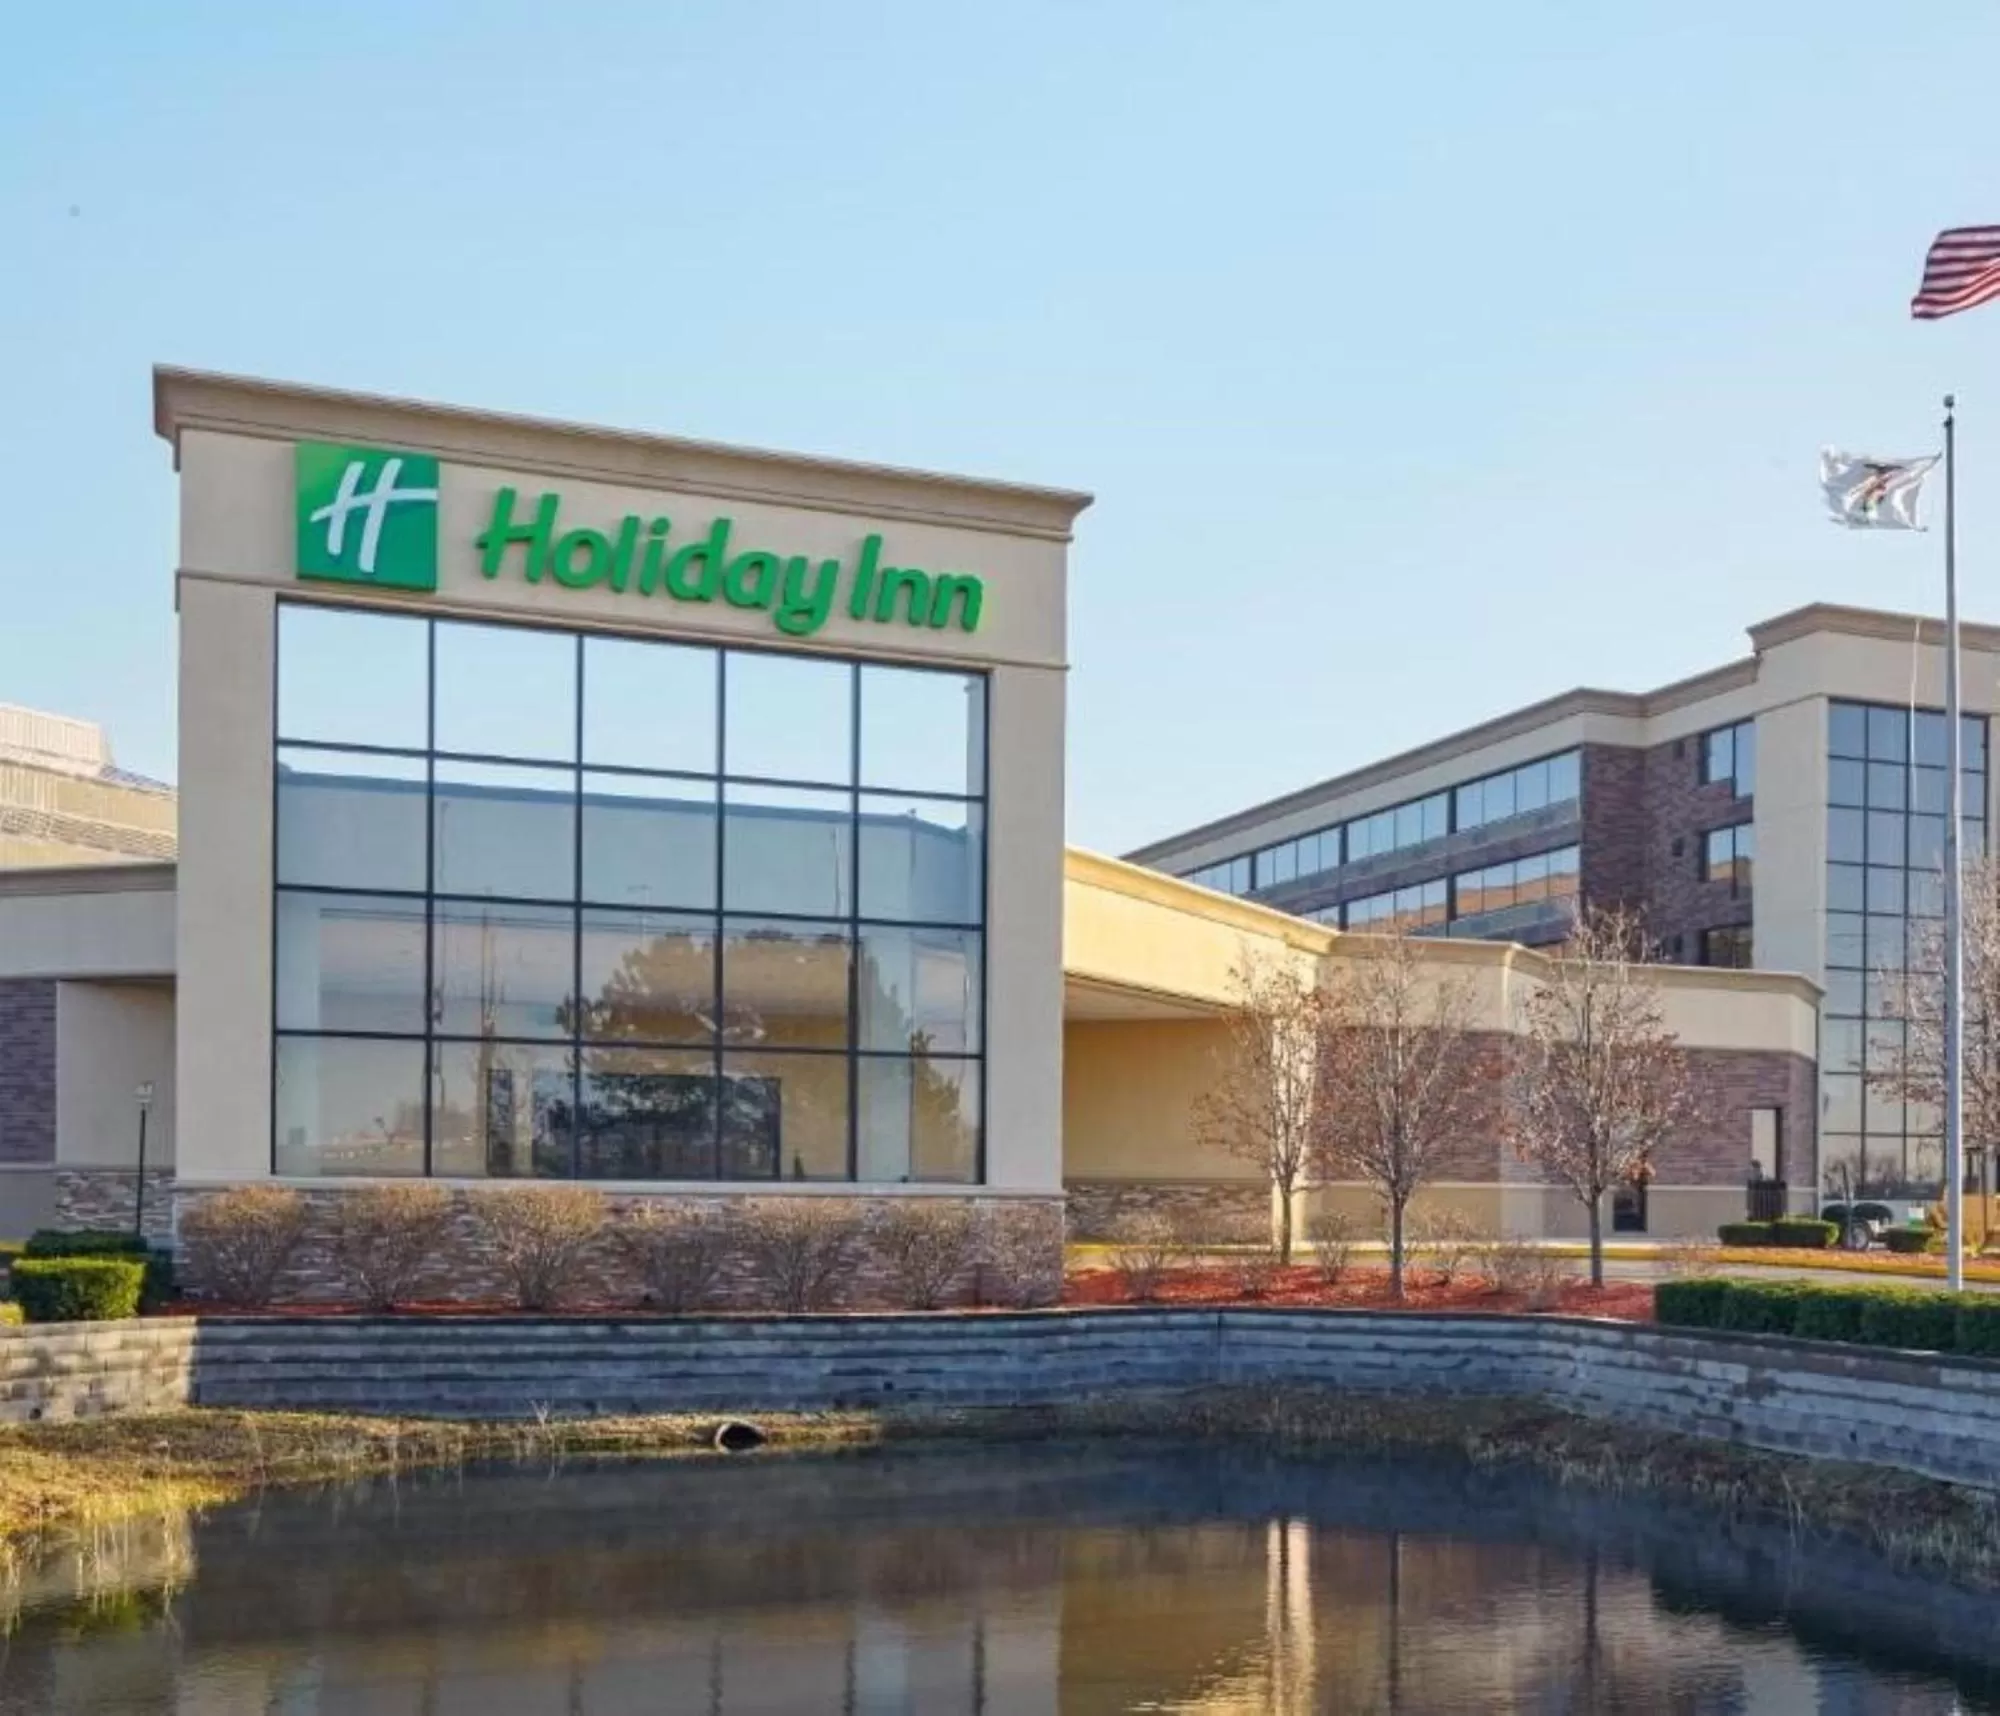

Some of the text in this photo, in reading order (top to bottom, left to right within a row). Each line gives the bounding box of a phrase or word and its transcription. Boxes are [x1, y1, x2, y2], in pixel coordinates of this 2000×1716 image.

[311, 458, 437, 573] H
[477, 487, 985, 635] Holiday Inn
